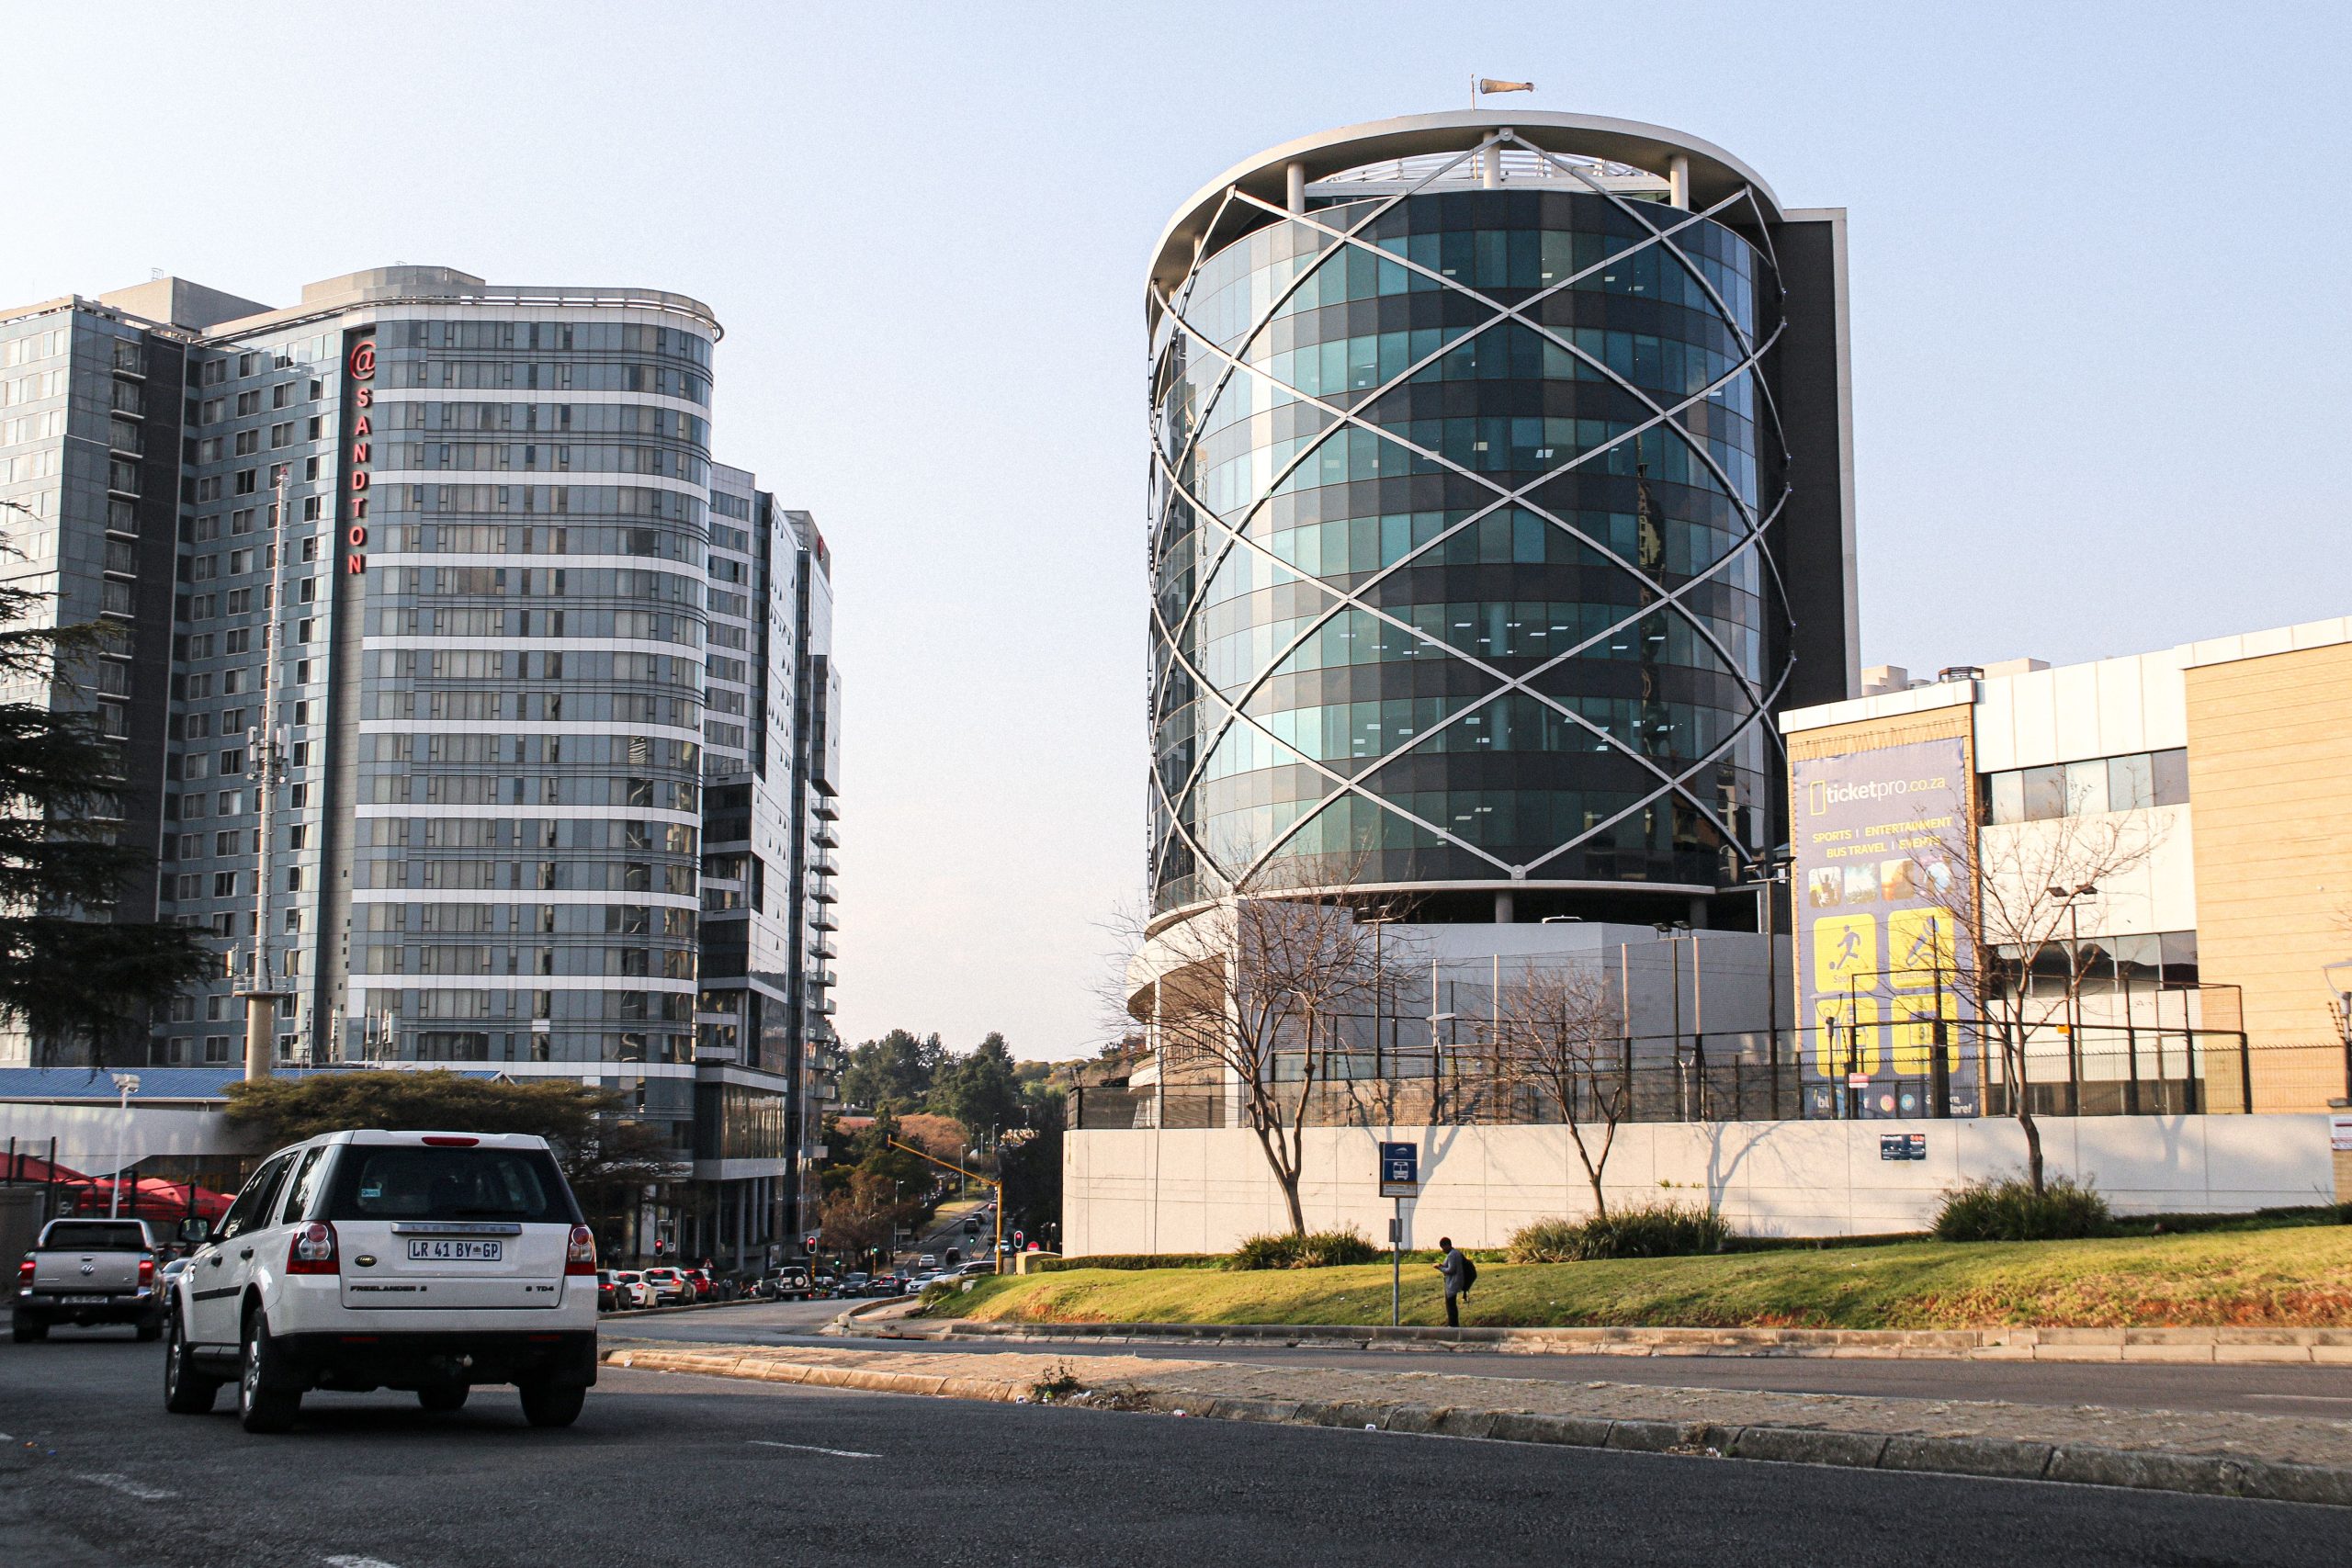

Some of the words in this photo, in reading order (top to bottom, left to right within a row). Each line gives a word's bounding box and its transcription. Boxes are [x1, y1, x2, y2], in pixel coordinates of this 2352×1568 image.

[1826, 777, 1947, 804] ticketpro.co.za
[1812, 829, 1853, 843] SPORTS
[1864, 817, 1953, 837] ENTERTAINMENT
[1826, 847, 1848, 859] BUS
[1848, 842, 1888, 856] TRAVEL
[1898, 835, 1941, 850] EVENTS
[412, 1242, 429, 1258] LR
[435, 1242, 450, 1258] 41
[456, 1242, 472, 1258] BY
[482, 1243, 499, 1258] GP
